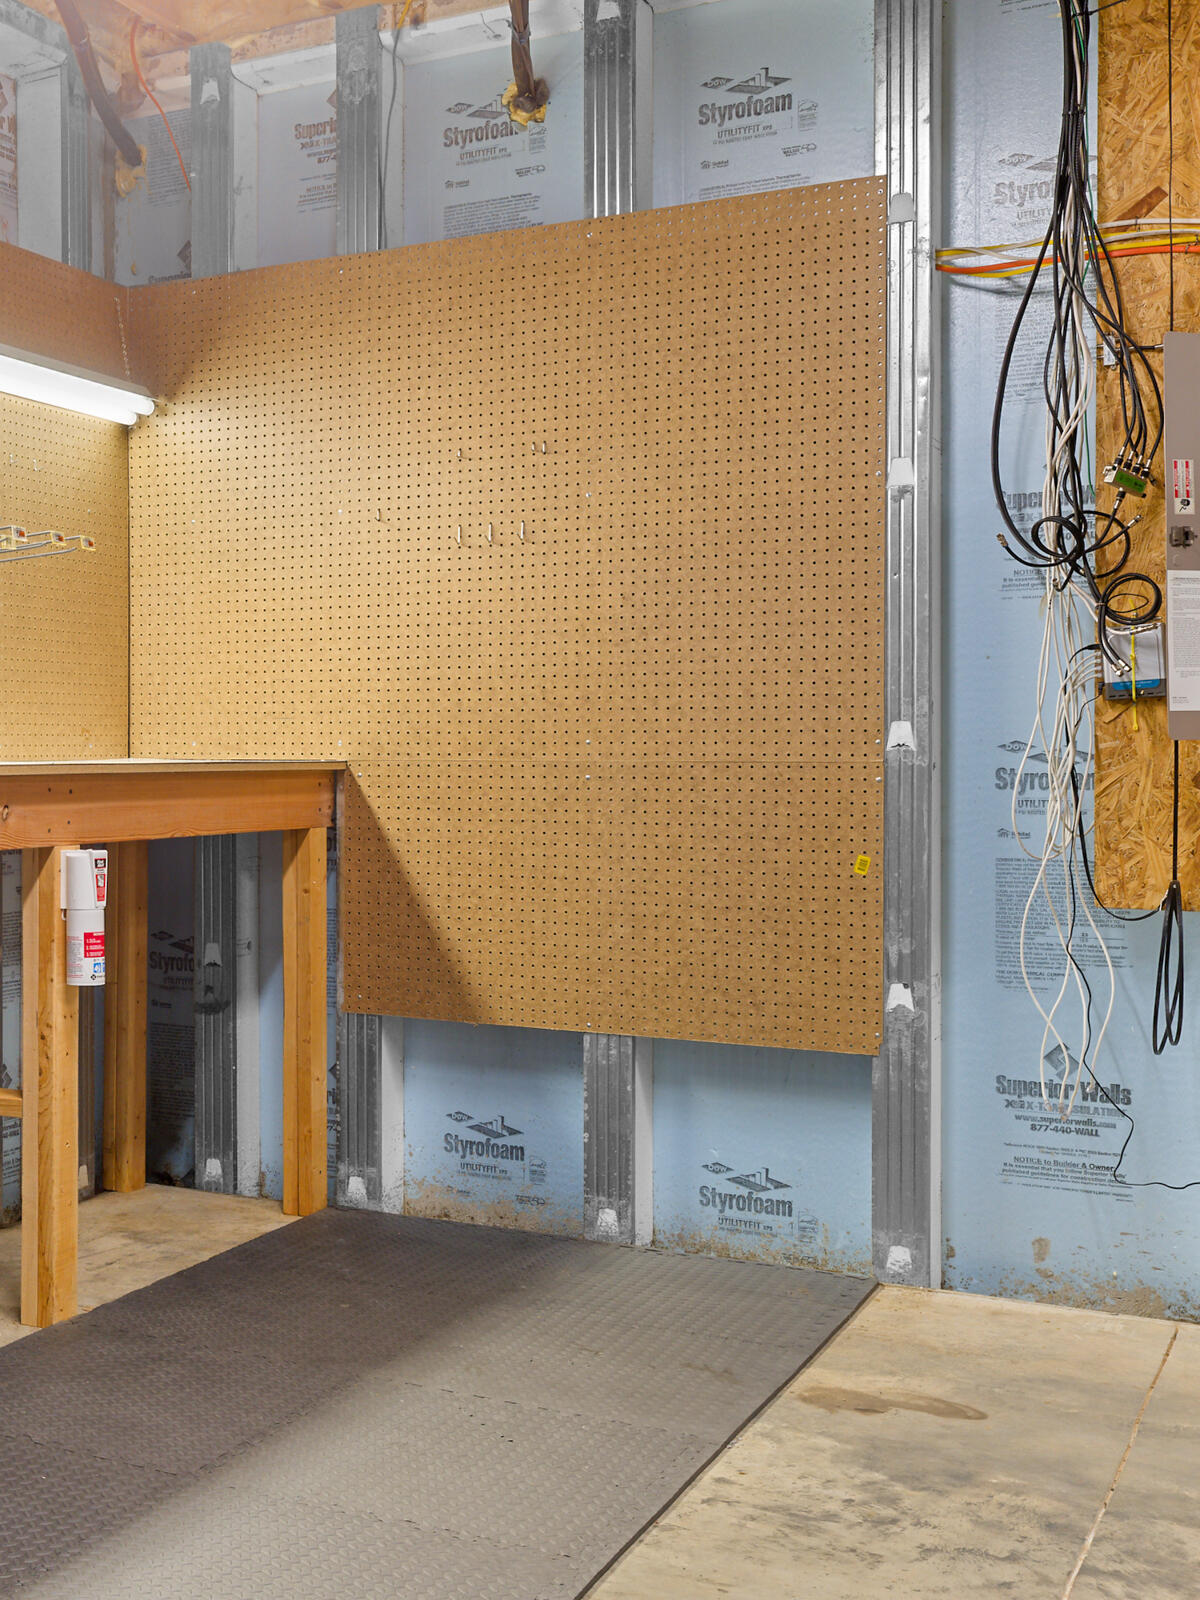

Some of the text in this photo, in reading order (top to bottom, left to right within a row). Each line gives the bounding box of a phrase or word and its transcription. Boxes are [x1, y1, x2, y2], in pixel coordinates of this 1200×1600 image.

[698, 92, 793, 127] Styrofoam
[995, 1075, 1074, 1103] Superior
[1014, 1114, 1117, 1129] www.superorwalls.com
[1030, 1123, 1101, 1137] 877-440-WALL
[443, 1133, 525, 1162] Styrofoam
[699, 1185, 793, 1218] Styrofoam
